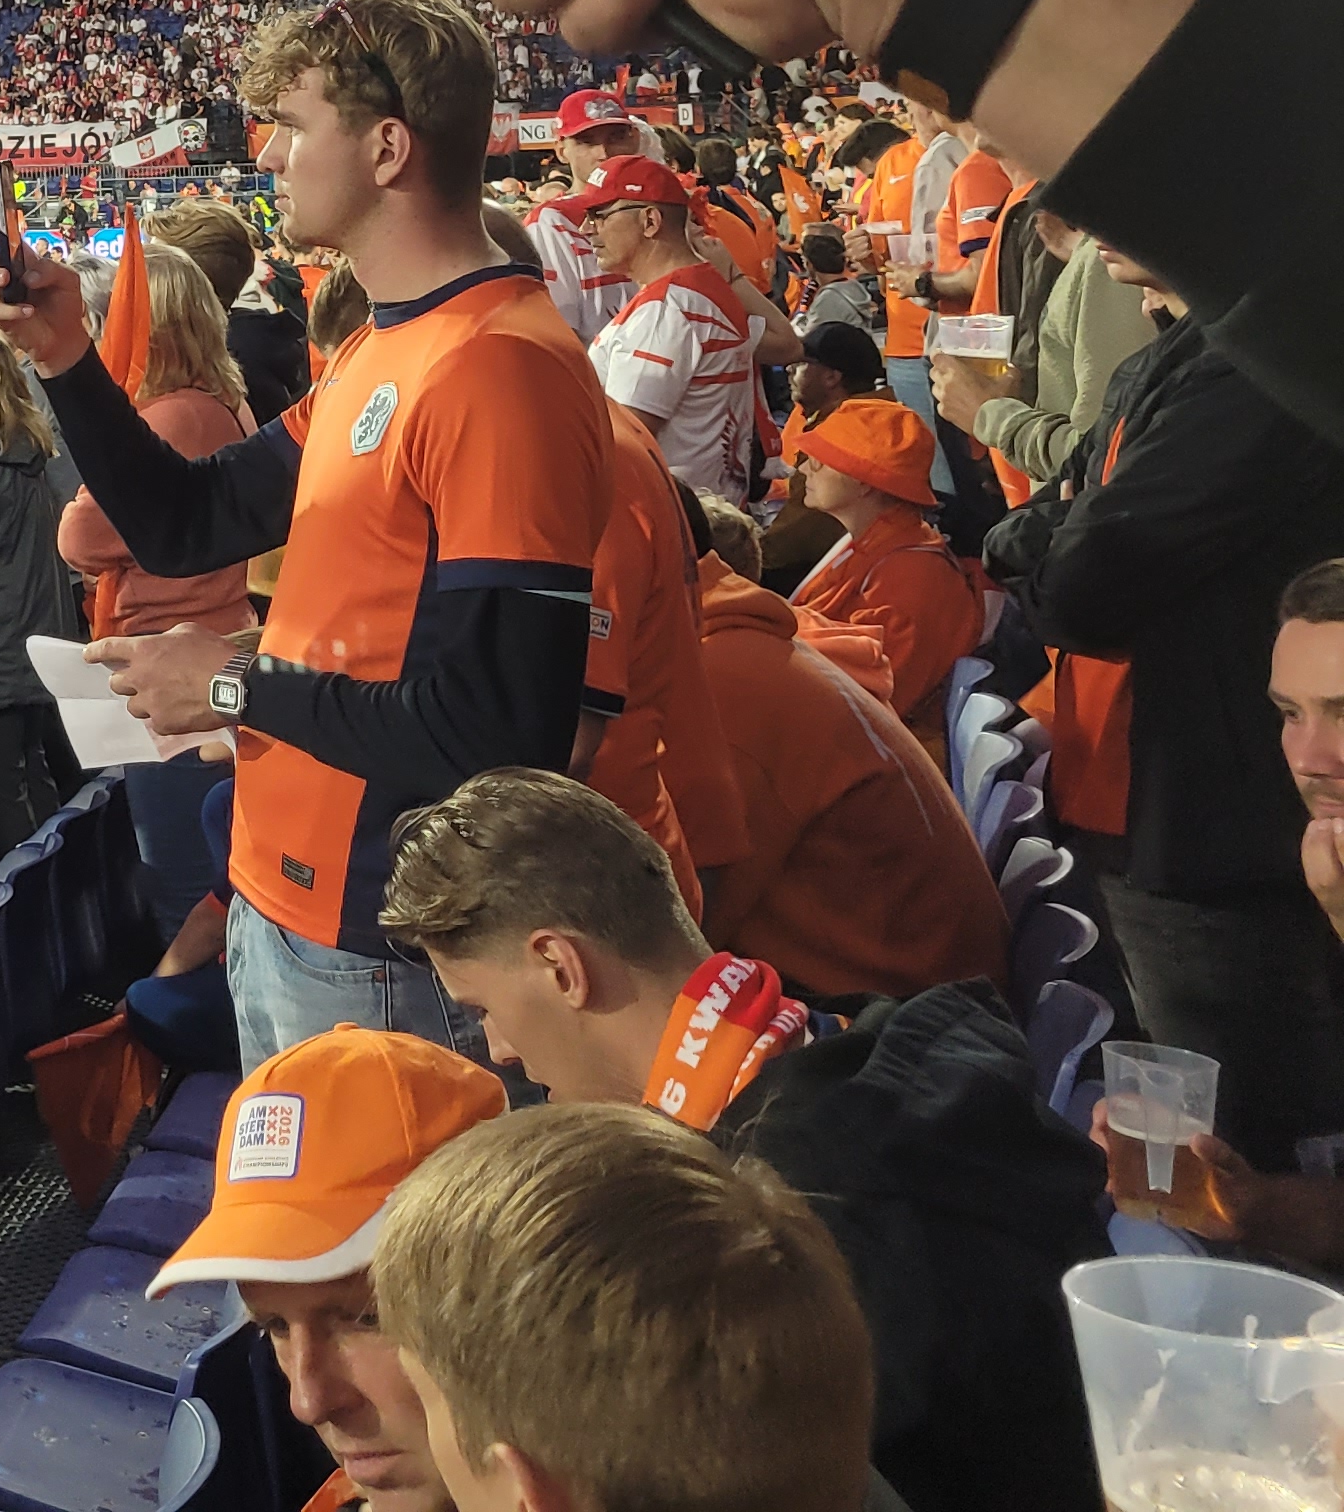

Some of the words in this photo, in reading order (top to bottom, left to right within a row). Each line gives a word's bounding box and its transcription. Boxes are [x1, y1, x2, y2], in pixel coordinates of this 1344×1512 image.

[681, 108, 690, 121] D
[520, 125, 546, 140] NG
[248, 1105, 267, 1119] AM
[238, 1119, 266, 1136] STER
[278, 1106, 293, 1147] 2016
[239, 1133, 265, 1149] DAM
